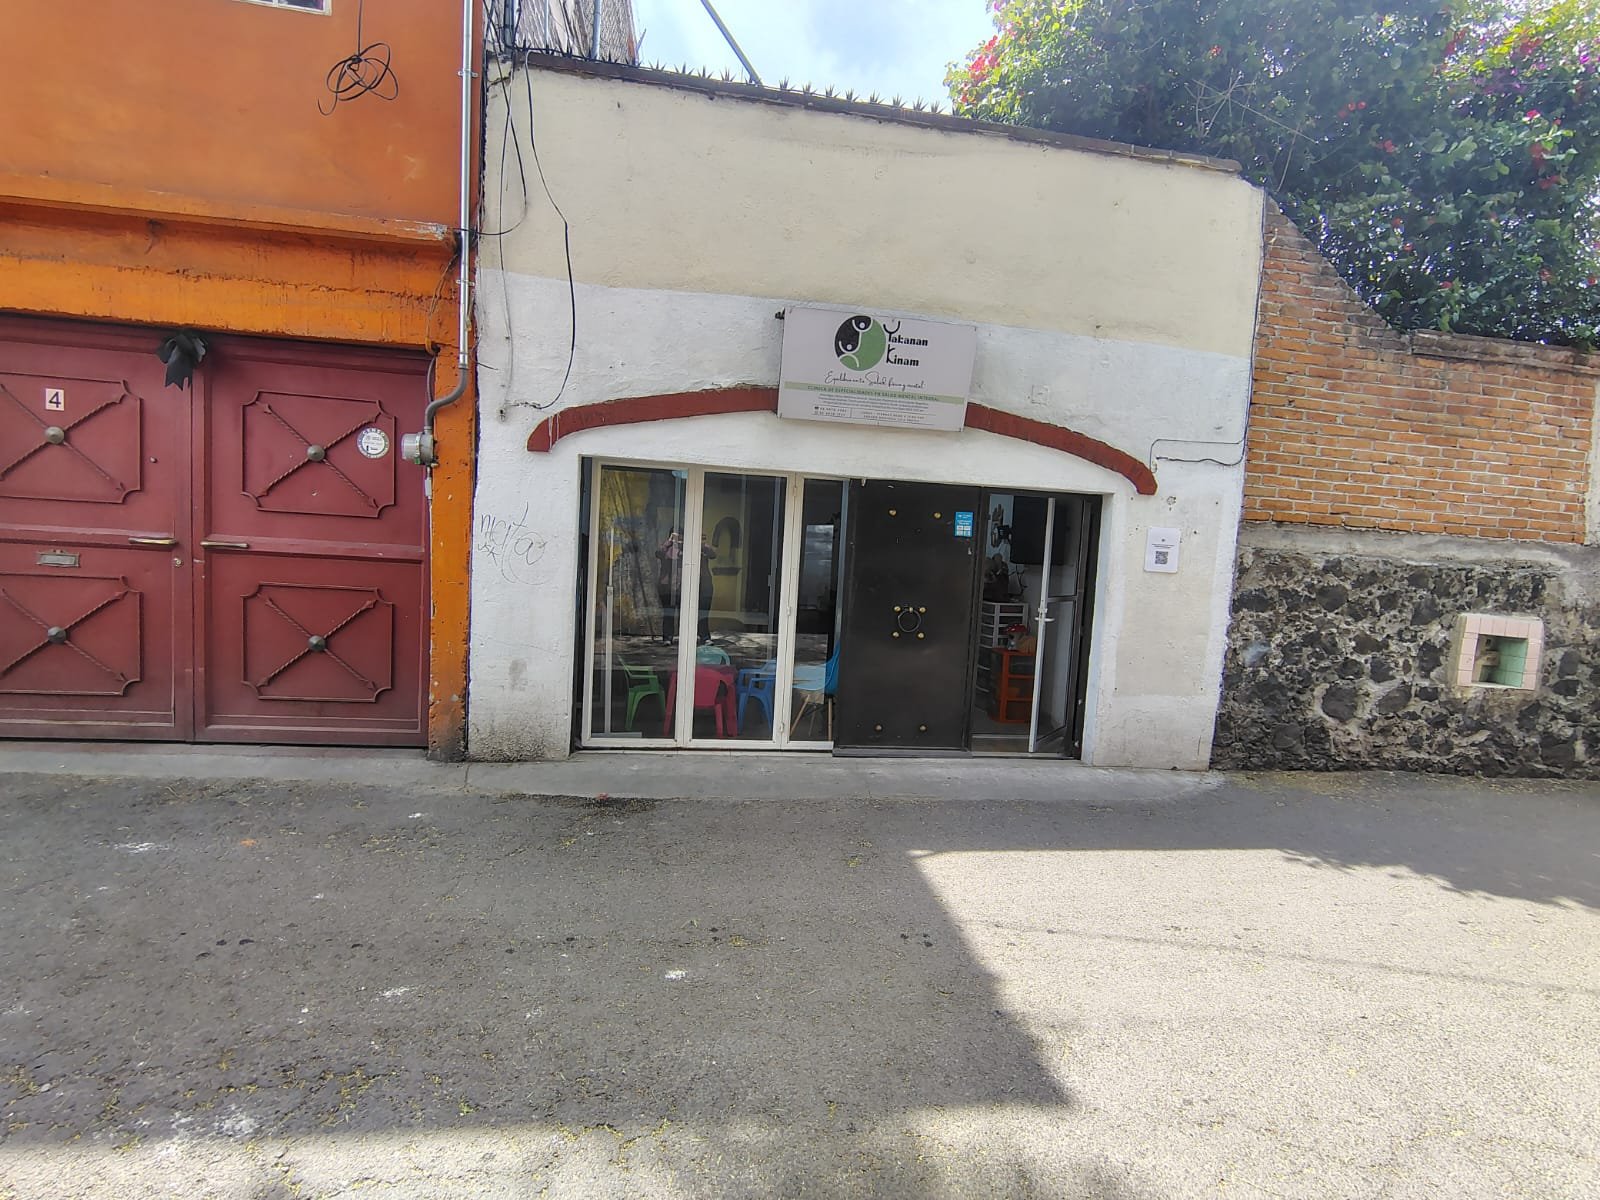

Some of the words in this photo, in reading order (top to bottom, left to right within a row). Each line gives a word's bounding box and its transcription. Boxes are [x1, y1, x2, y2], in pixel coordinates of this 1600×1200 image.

[883, 320, 928, 346] Yakanan
[886, 343, 919, 367] Kinam
[48, 391, 62, 408] 4
